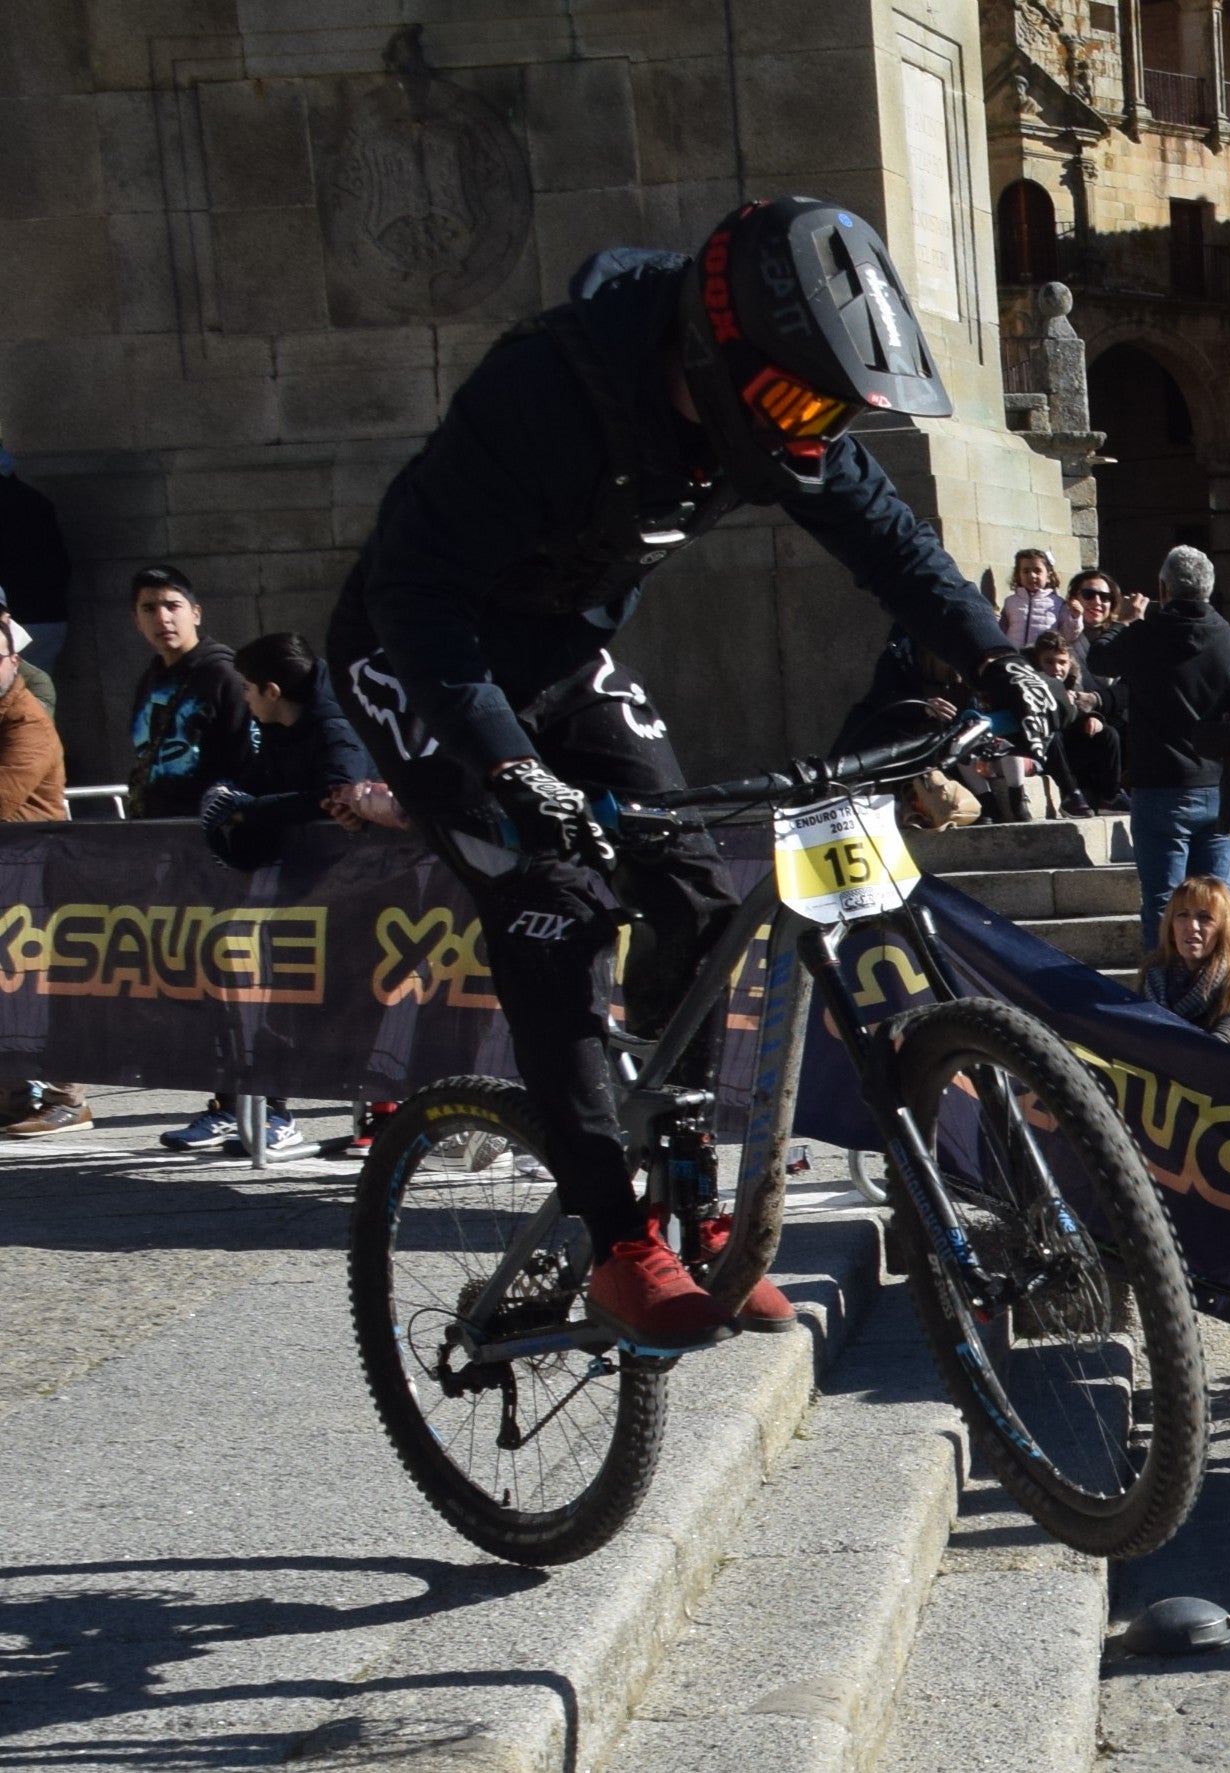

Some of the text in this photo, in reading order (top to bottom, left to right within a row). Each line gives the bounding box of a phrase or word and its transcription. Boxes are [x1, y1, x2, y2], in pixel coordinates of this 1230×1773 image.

[796, 810, 838, 829] ENDURO
[830, 820, 855, 834] 2023
[823, 842, 871, 888] 15
[507, 910, 577, 941] FOX
